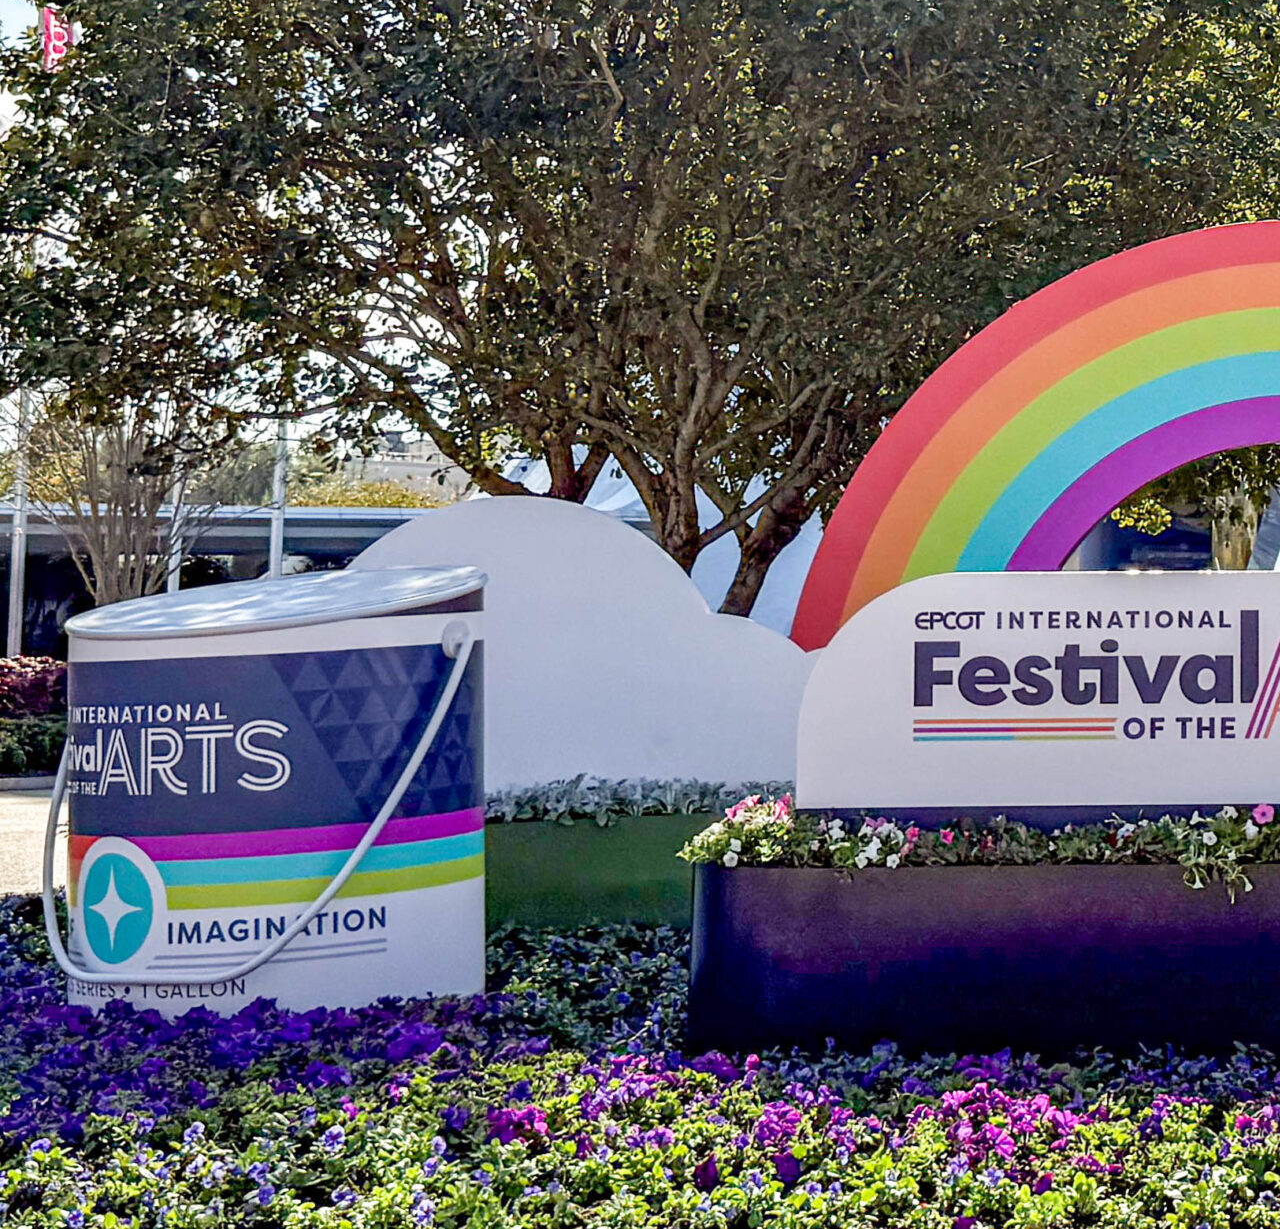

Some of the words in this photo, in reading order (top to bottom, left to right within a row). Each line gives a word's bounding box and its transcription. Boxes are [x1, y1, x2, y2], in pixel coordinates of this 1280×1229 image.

[914, 611, 986, 630] EPCOT
[997, 610, 1232, 630] INTERNATIONAL
[913, 610, 1260, 707] Festival
[1122, 717, 1166, 740] OF
[1176, 717, 1237, 740] THE
[67, 728, 103, 772] ival
[98, 719, 291, 796] ARTS
[155, 978, 245, 999] GALLON
